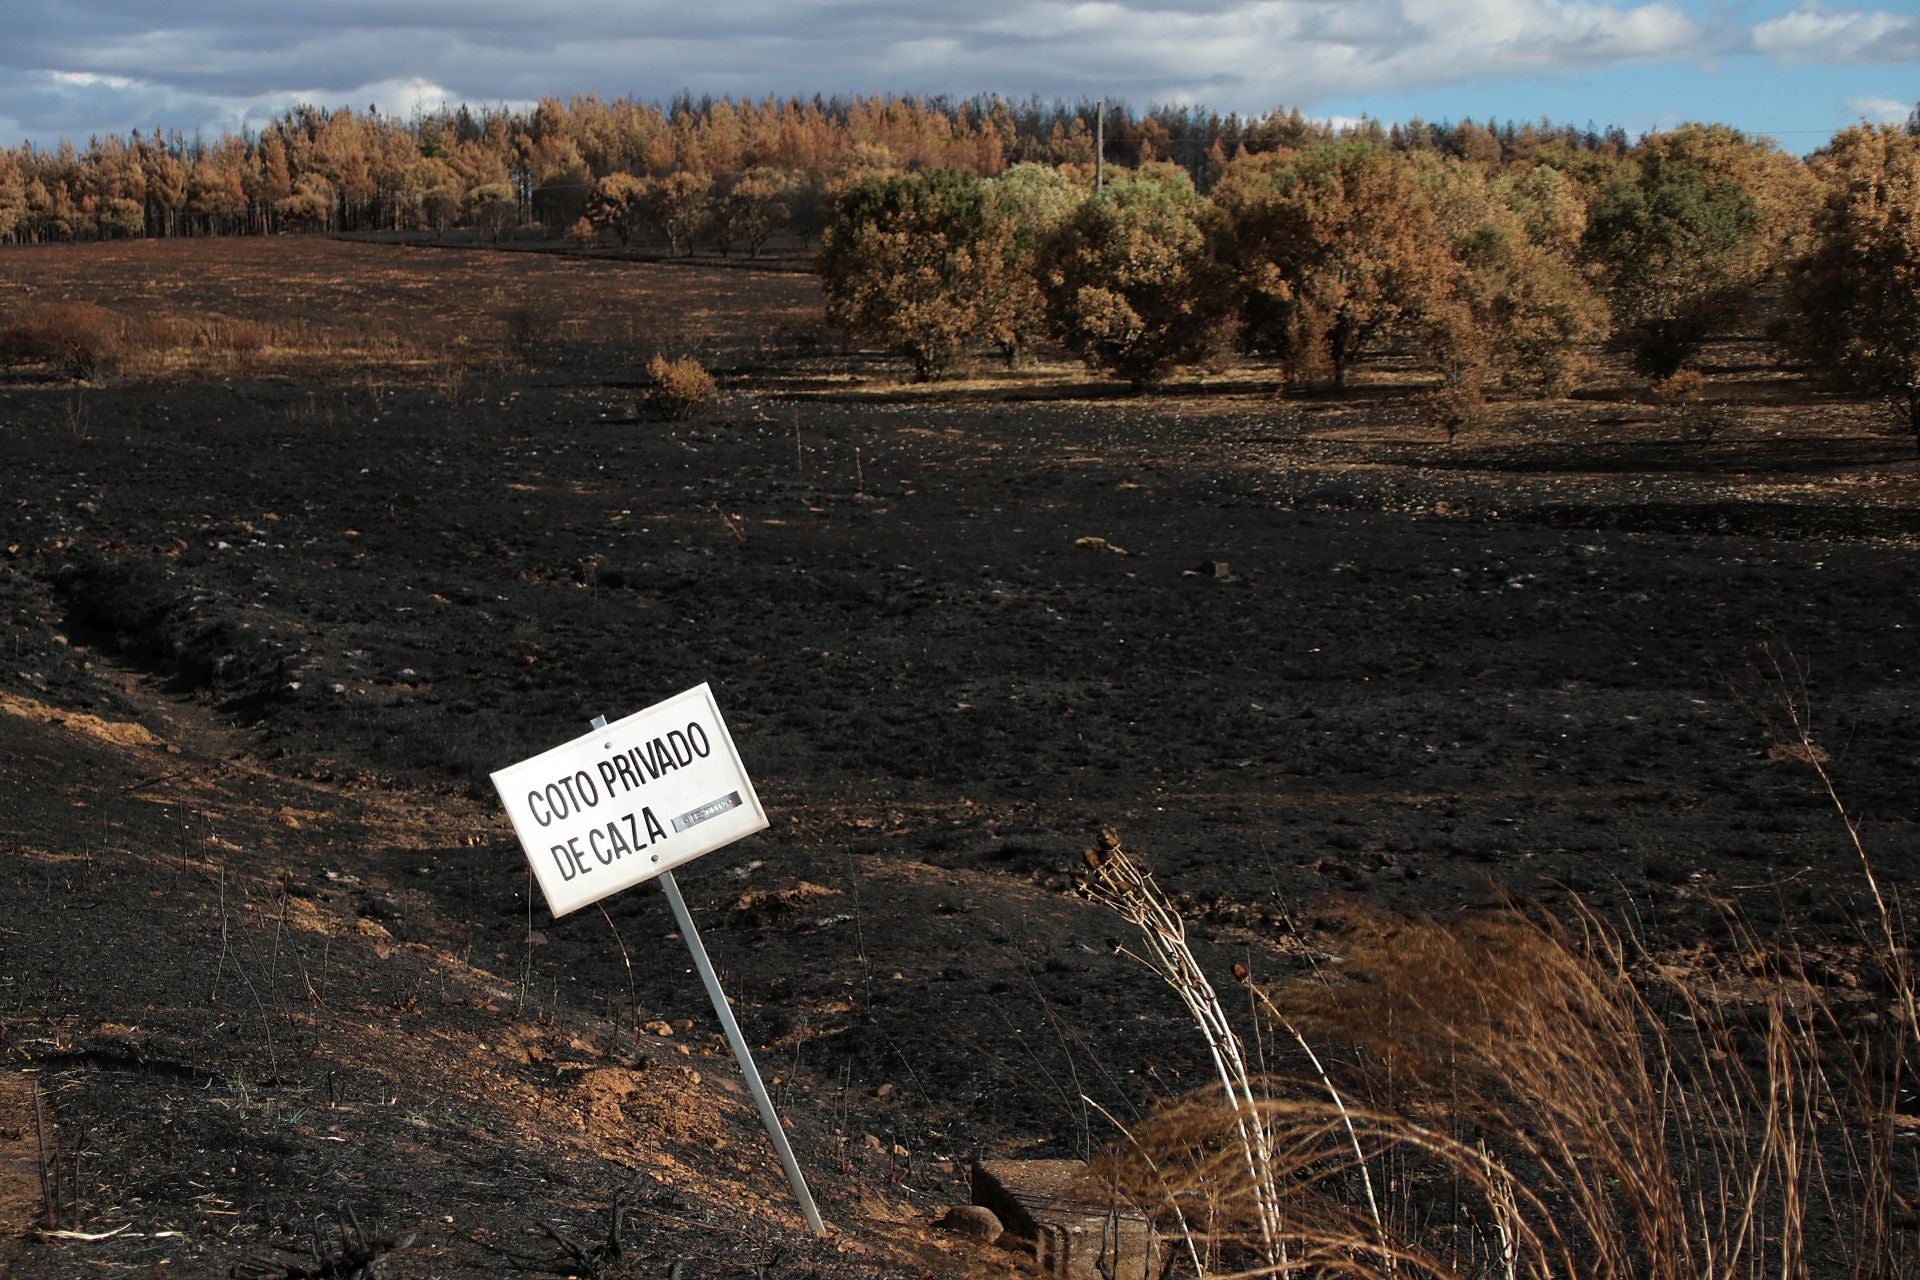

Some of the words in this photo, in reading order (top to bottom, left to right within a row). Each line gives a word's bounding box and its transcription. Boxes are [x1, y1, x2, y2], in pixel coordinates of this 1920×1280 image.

[528, 771, 599, 827] COTO
[597, 722, 710, 798] PRIVADO
[551, 837, 592, 882] DE
[590, 806, 667, 865] CAZA
